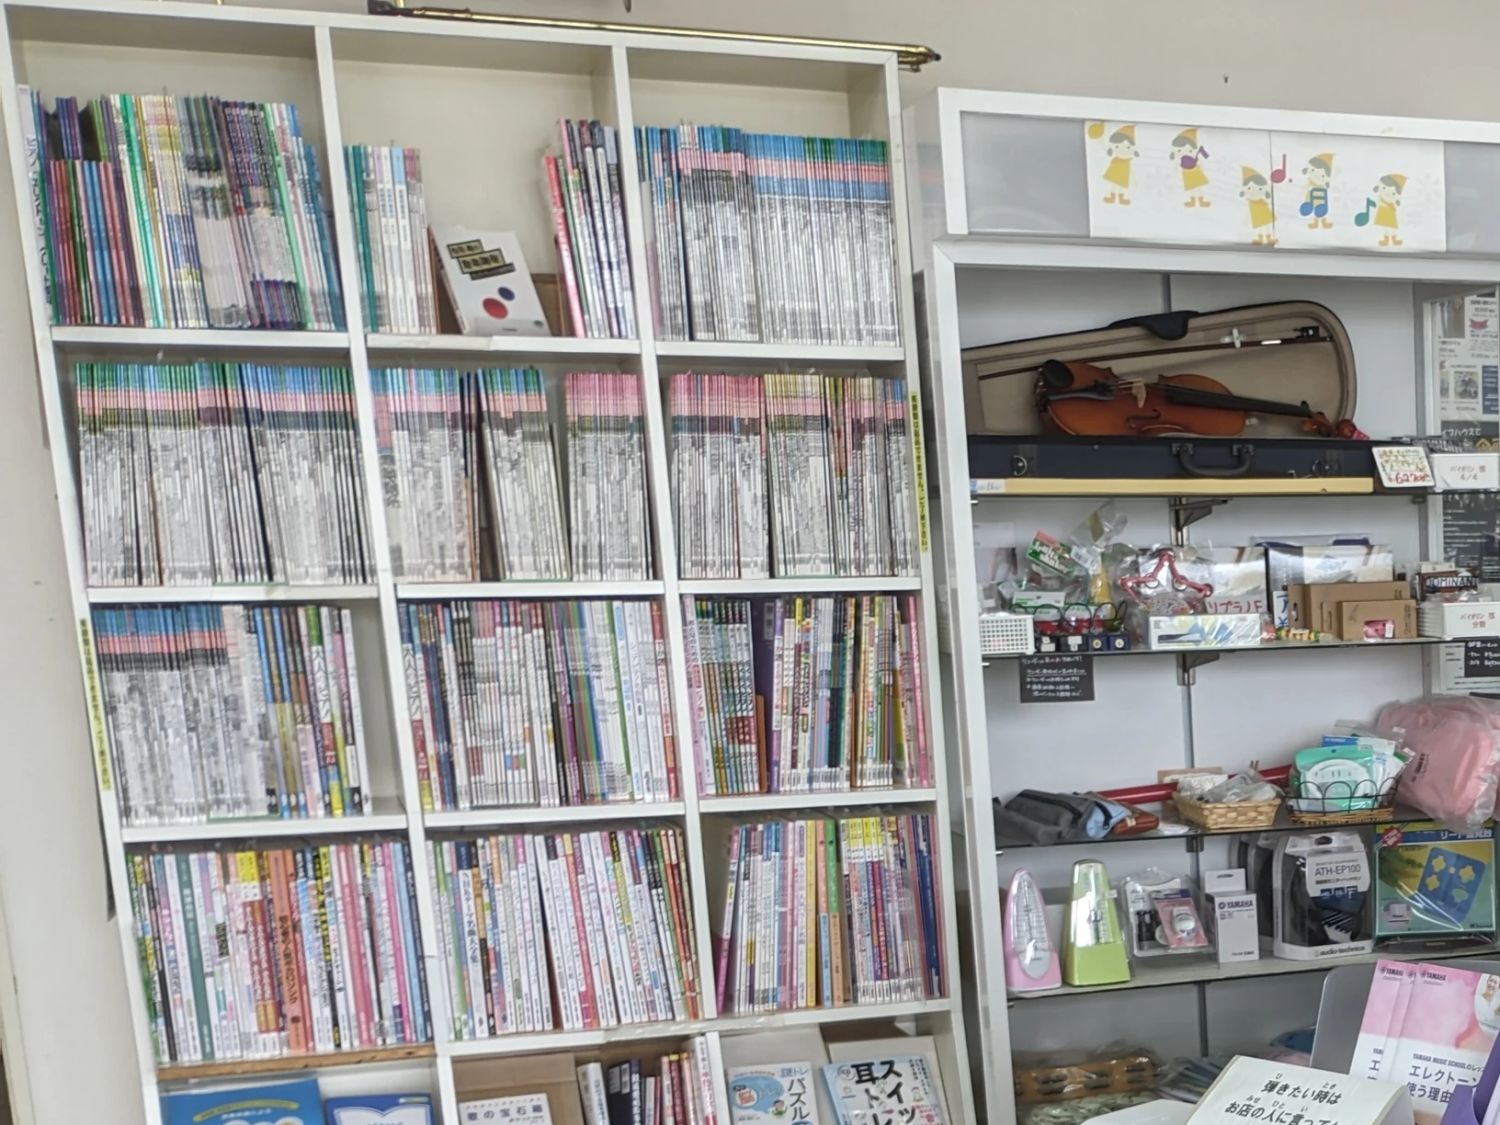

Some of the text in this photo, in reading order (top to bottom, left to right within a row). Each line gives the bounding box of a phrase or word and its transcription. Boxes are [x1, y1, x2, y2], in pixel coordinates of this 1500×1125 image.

[1315, 863, 1361, 877] ATH-EP100
[1227, 899, 1253, 910] YAMAHA
[1409, 1065, 1477, 1085] エレクトー
[788, 1077, 810, 1121] パズル
[1261, 1079, 1342, 1105] 弾きたい時は
